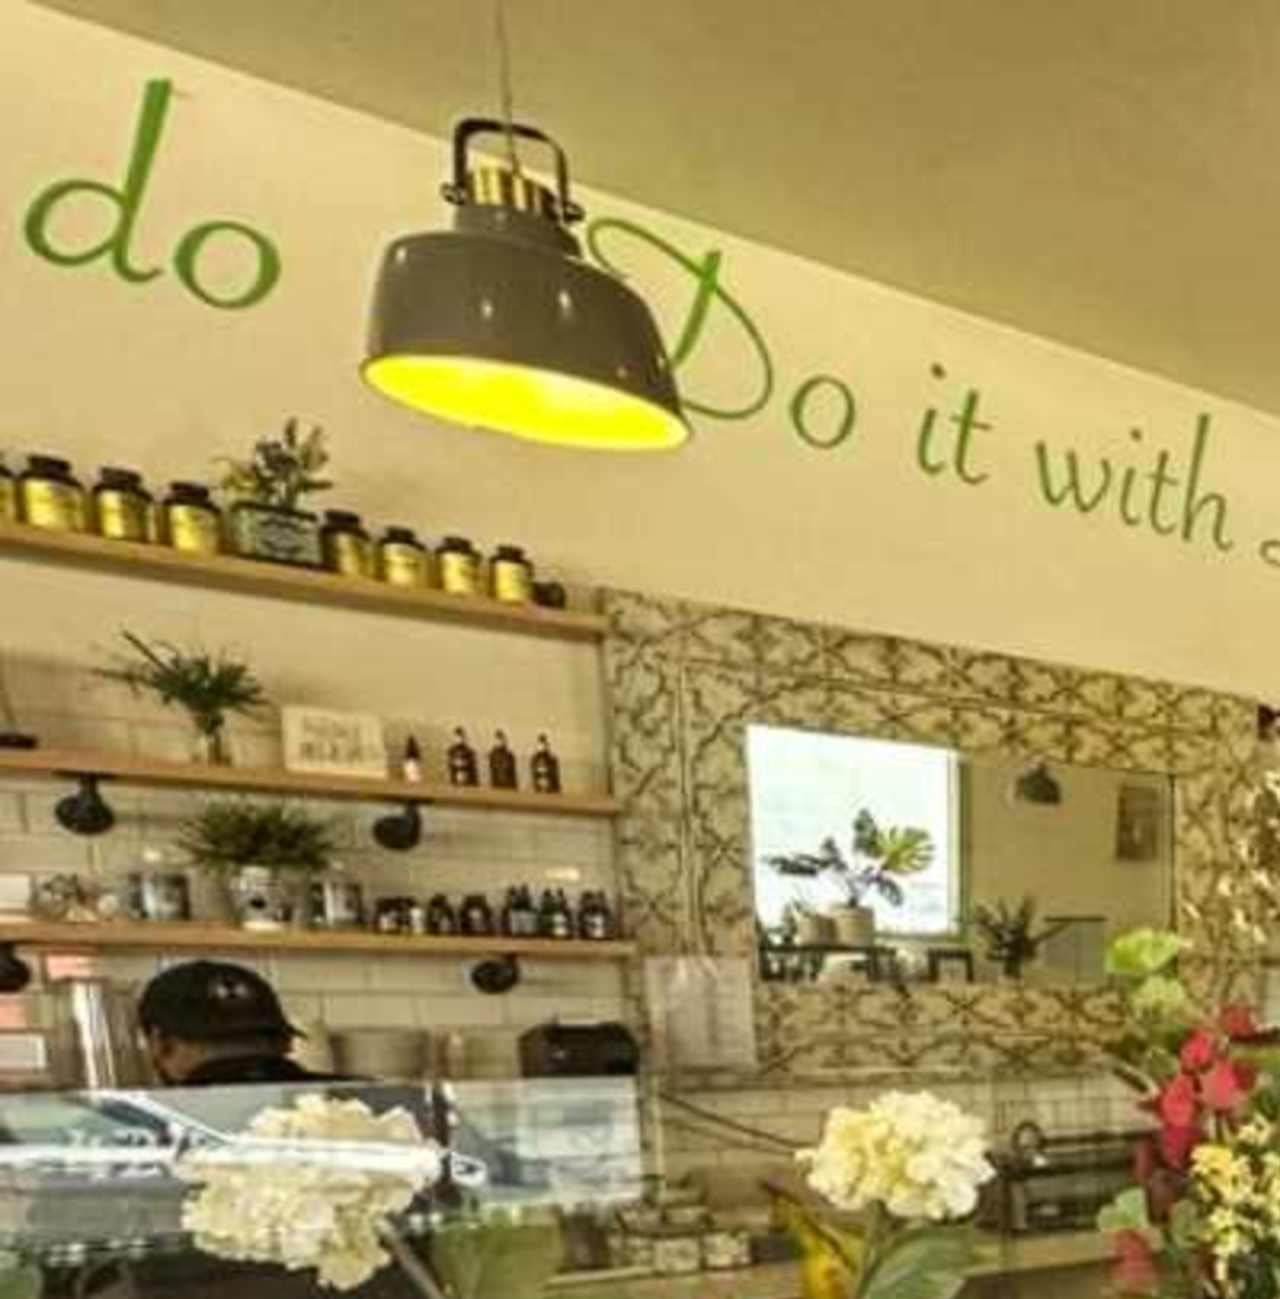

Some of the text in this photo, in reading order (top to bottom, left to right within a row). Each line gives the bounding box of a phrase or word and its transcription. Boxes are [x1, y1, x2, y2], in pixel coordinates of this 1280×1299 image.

[21, 78, 282, 310] do
[585, 217, 857, 449] Do
[915, 363, 992, 486] it
[1035, 413, 1235, 551] with
